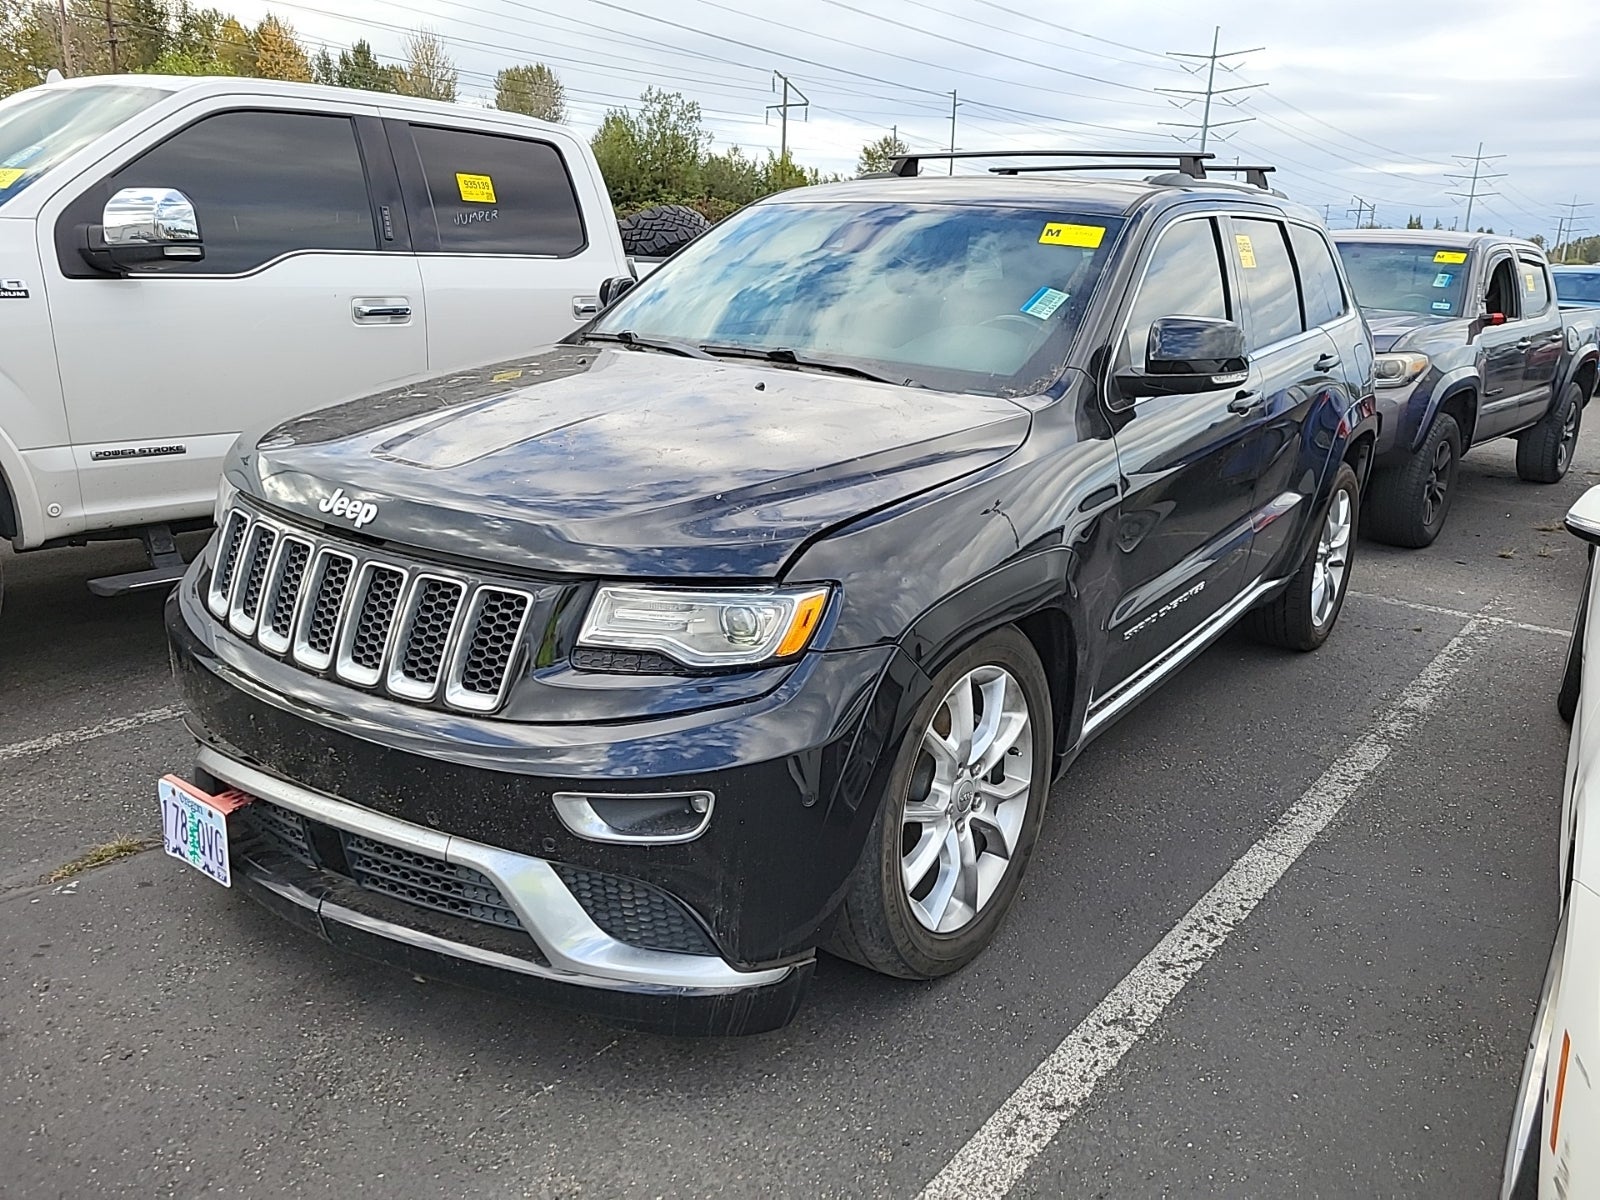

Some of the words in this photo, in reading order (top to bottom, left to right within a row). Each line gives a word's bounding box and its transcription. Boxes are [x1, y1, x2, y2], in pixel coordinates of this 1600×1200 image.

[453, 209, 498, 226] JUMPER
[1045, 228, 1062, 238] M
[94, 448, 136, 458] POWER
[138, 444, 184, 455] STROKE
[318, 487, 379, 529] Jeep
